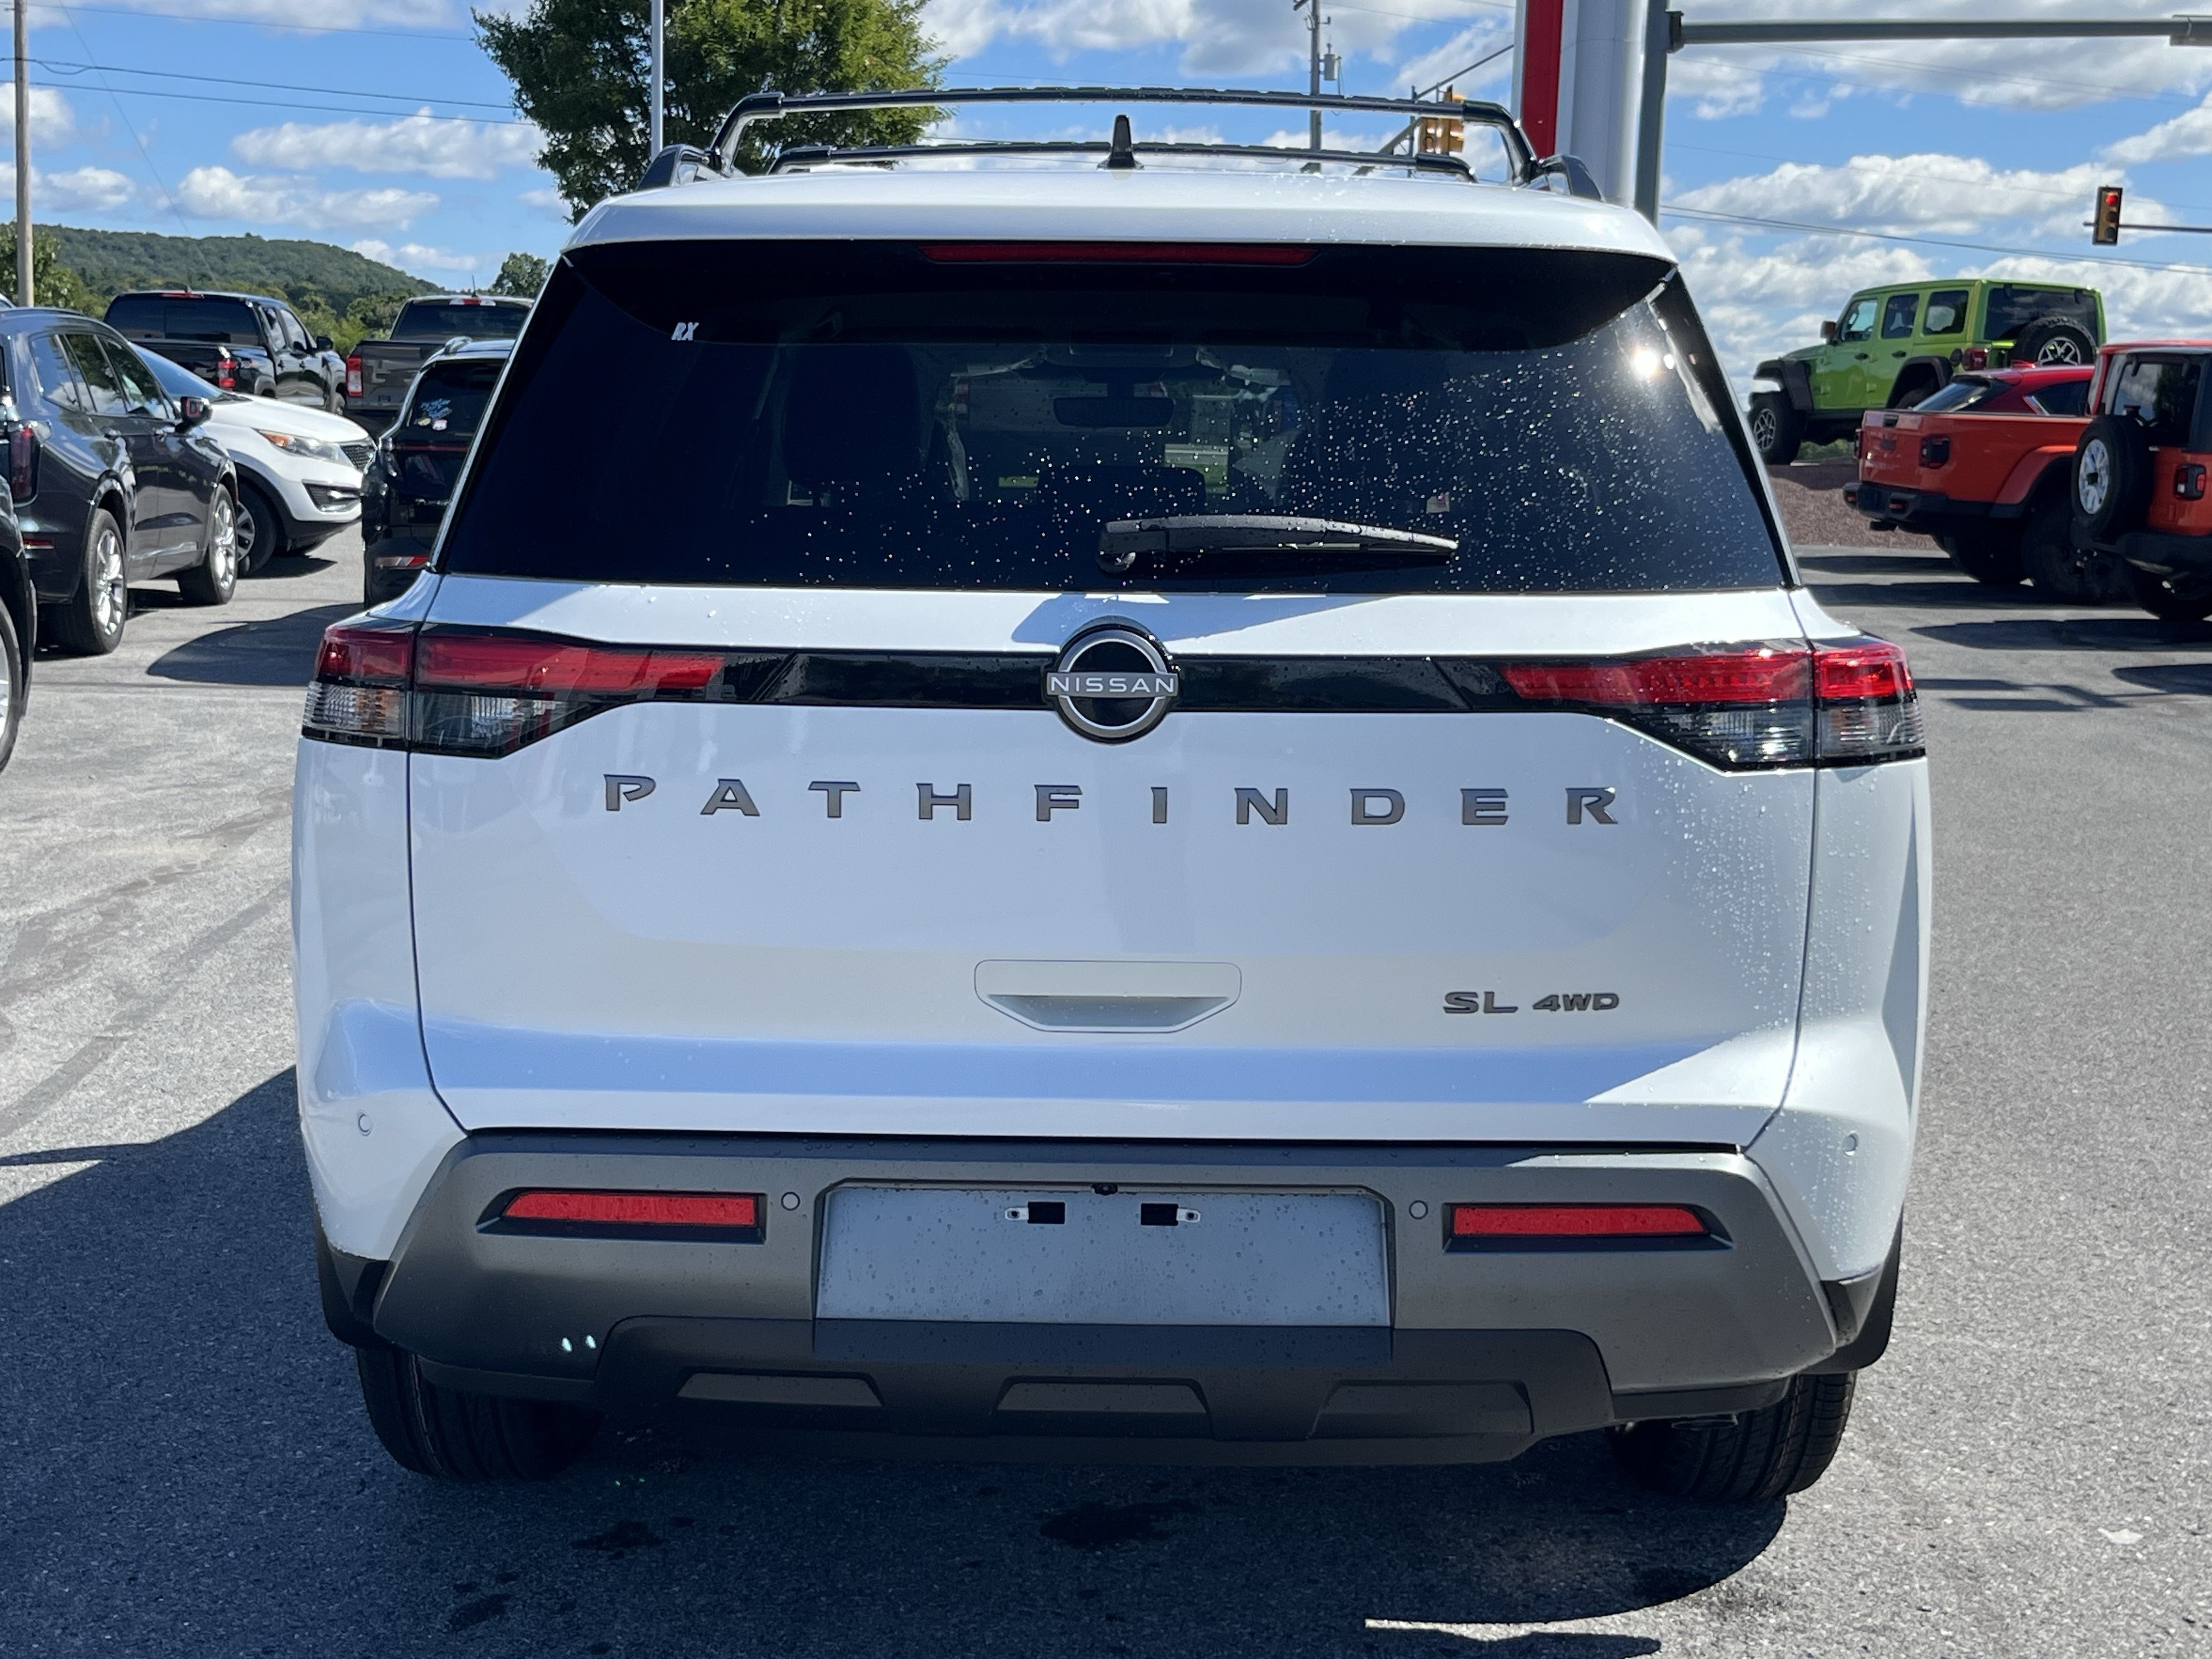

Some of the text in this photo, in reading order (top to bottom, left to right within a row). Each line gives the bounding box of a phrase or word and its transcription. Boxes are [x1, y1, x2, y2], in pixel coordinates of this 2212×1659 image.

[671, 321, 699, 341] RX
[1050, 676, 1174, 693] NISSAN
[603, 774, 1618, 825] PATHFINDER
[1443, 991, 1620, 1014] SL 4WD
